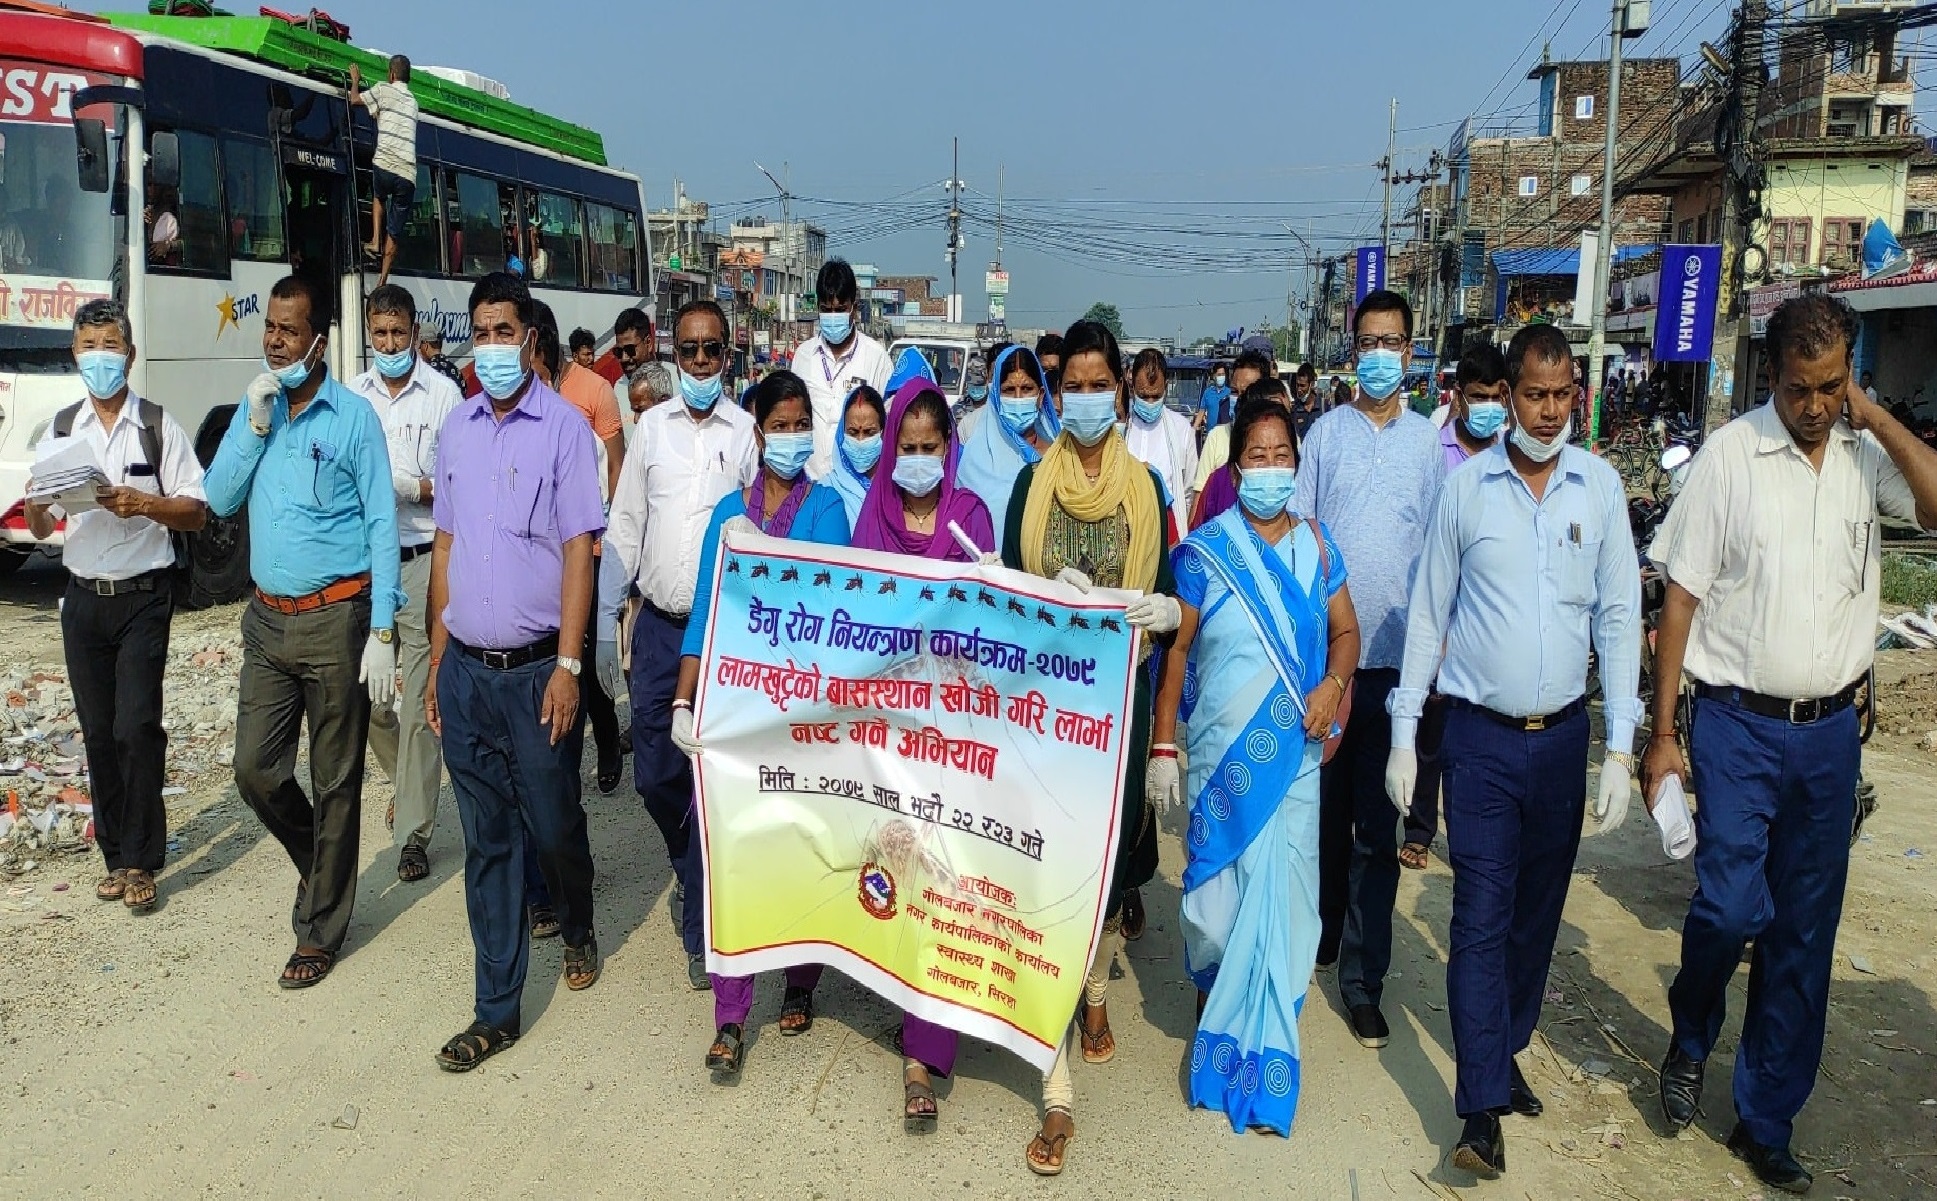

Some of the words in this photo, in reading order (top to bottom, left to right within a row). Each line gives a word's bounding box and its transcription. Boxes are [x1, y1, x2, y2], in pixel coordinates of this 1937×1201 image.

[0, 68, 89, 119] ST
[231, 292, 261, 321] STAR
[1677, 277, 1700, 353] YAMAHA
[785, 602, 825, 644] रोग
[827, 608, 923, 657] नियन्त्रण
[717, 655, 821, 712] लामखुट्टेको
[826, 676, 933, 710] बासस्थान
[940, 676, 1000, 719] खोजी
[1007, 690, 1048, 734] गरि
[1055, 709, 1114, 752] लार्भा
[789, 721, 839, 745] नष्ट
[896, 725, 999, 781] अभियान
[758, 764, 796, 791] मिति
[819, 776, 865, 799] २०७९
[873, 784, 900, 811] साल
[952, 808, 973, 831] २२
[1021, 829, 1045, 861] गते
[906, 903, 928, 924] नगर
[931, 917, 1013, 955] कार्यपालिकाको
[1015, 948, 1061, 980] कार्यालय
[981, 908, 1044, 945] नगरपालिका
[936, 943, 985, 970] स्वास्थ्य
[991, 961, 1017, 984] शाखा
